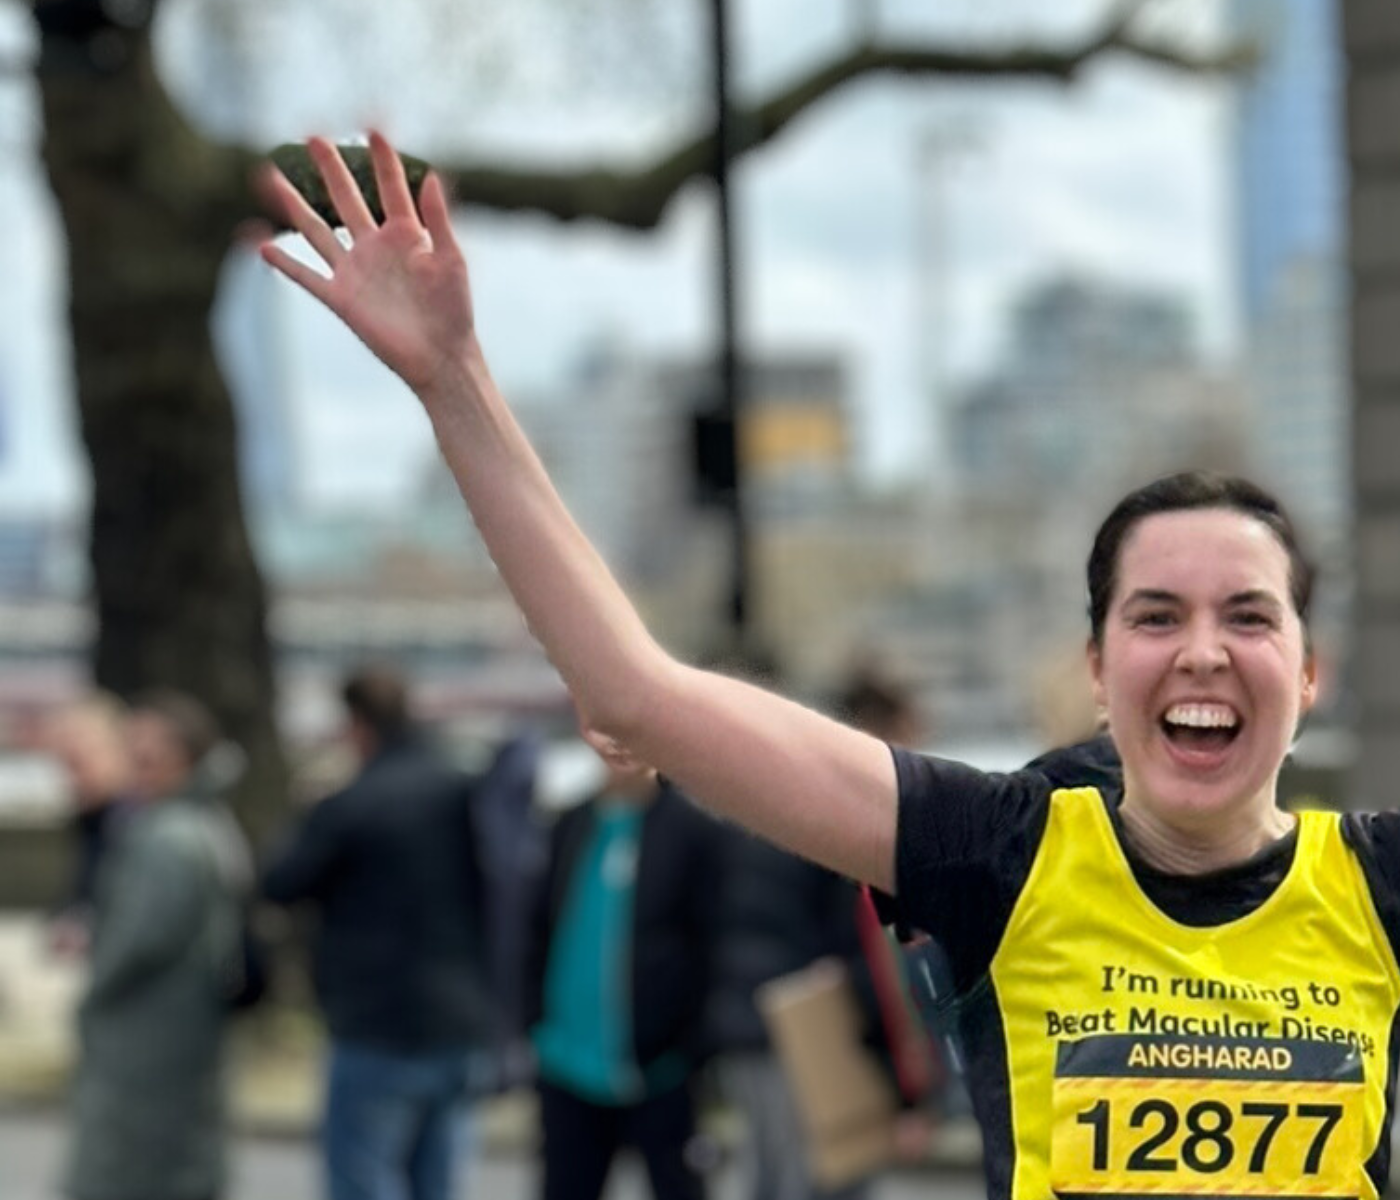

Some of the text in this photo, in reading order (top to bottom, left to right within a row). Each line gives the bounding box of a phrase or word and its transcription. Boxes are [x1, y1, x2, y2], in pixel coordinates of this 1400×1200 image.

[1102, 965, 1341, 1010] I’m running to
[1045, 1008, 1116, 1036] Beat
[1129, 1007, 1270, 1037] Macular
[1127, 1043, 1292, 1071] ANGHARAD
[1077, 1099, 1343, 1174] 12877
